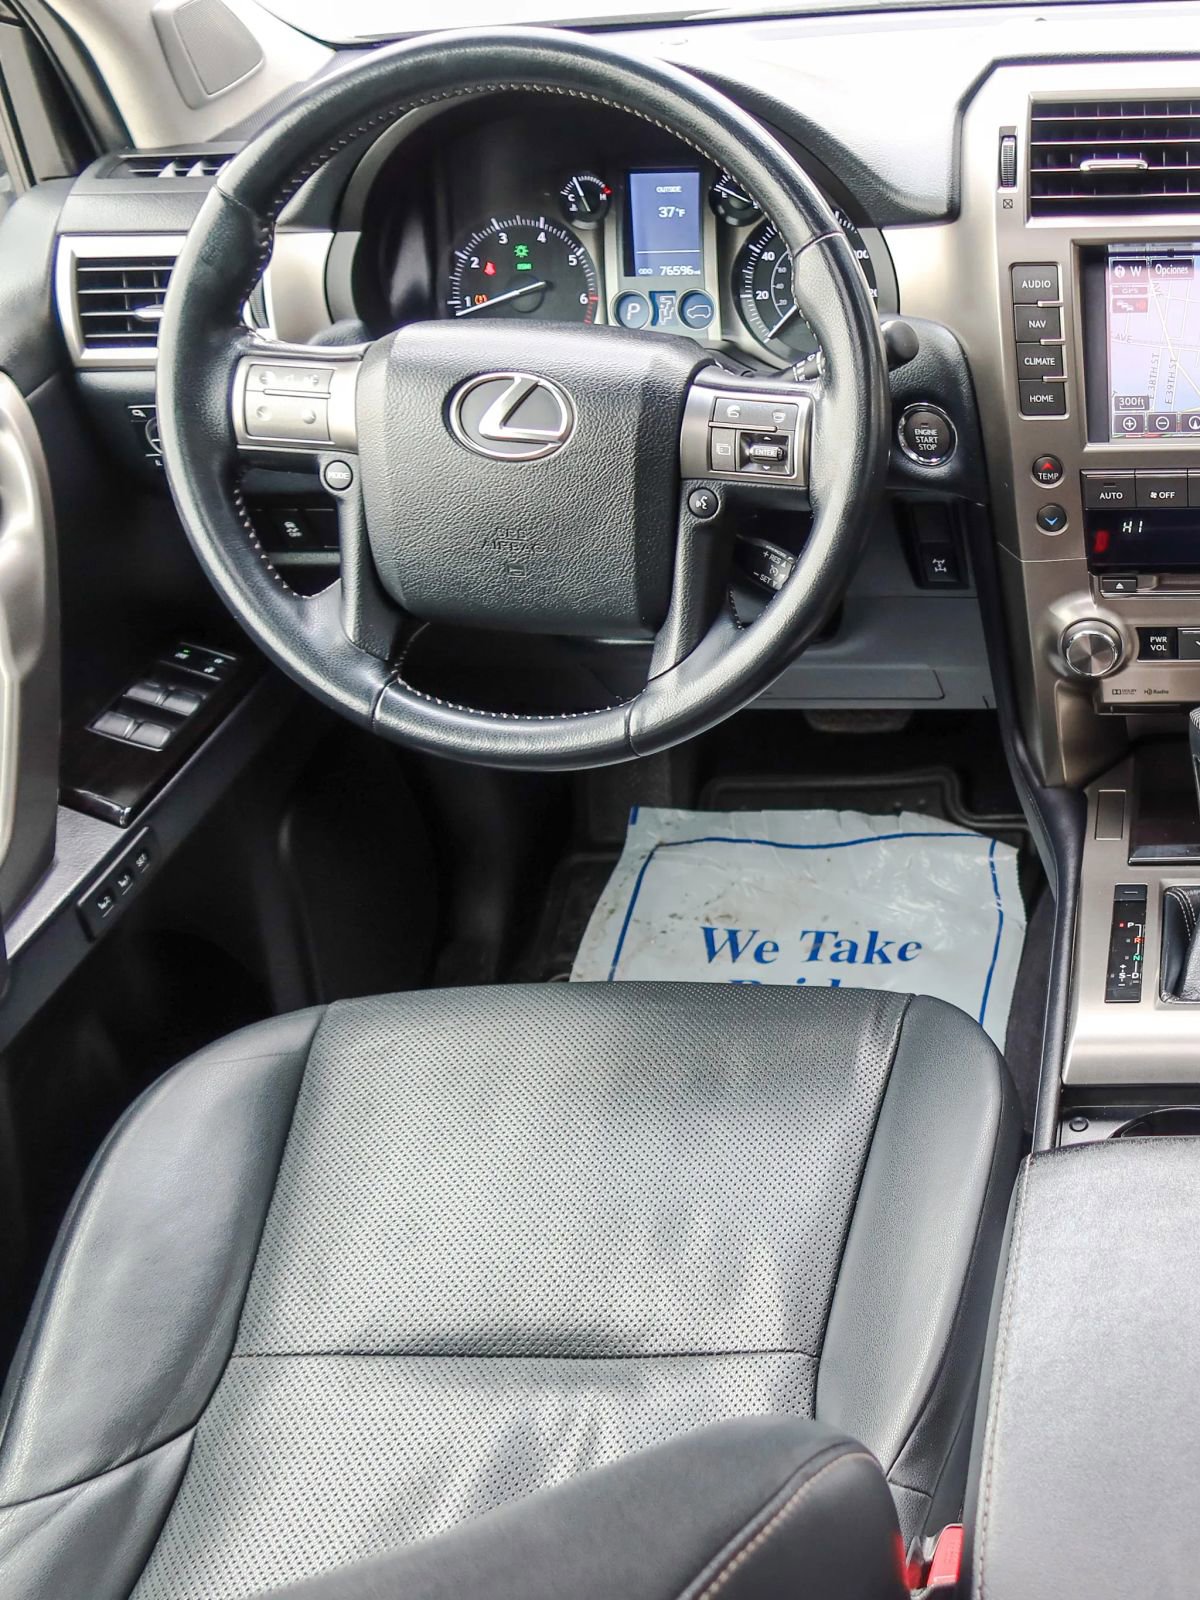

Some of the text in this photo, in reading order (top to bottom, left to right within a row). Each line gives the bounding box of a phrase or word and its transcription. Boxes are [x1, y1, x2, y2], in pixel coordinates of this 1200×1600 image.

[499, 233, 508, 244] 3
[537, 232, 547, 243] 4
[761, 251, 775, 260] 40
[470, 257, 480, 268] 2
[568, 255, 578, 266] 5
[660, 266, 694, 276] 76596
[1130, 265, 1142, 277] W
[1155, 264, 1188, 277] Opciones
[1021, 280, 1051, 289] AUDIO
[580, 293, 588, 304] 6
[756, 291, 769, 300] 20
[464, 296, 471, 306] 1
[1028, 320, 1047, 329] NAV
[1024, 357, 1056, 366] CLIMATE
[1029, 395, 1054, 403] HOME
[1119, 397, 1144, 406] 300ft
[914, 428, 938, 436] ENGINE
[918, 443, 937, 451] STOP
[754, 449, 777, 457] ENTER
[327, 471, 350, 480] MODE
[1037, 472, 1059, 480] TEMP
[1099, 492, 1123, 500] AUTO
[1159, 491, 1176, 499] OFF
[769, 553, 782, 564] RES
[760, 574, 772, 584] SET
[700, 926, 923, 964] We Take
